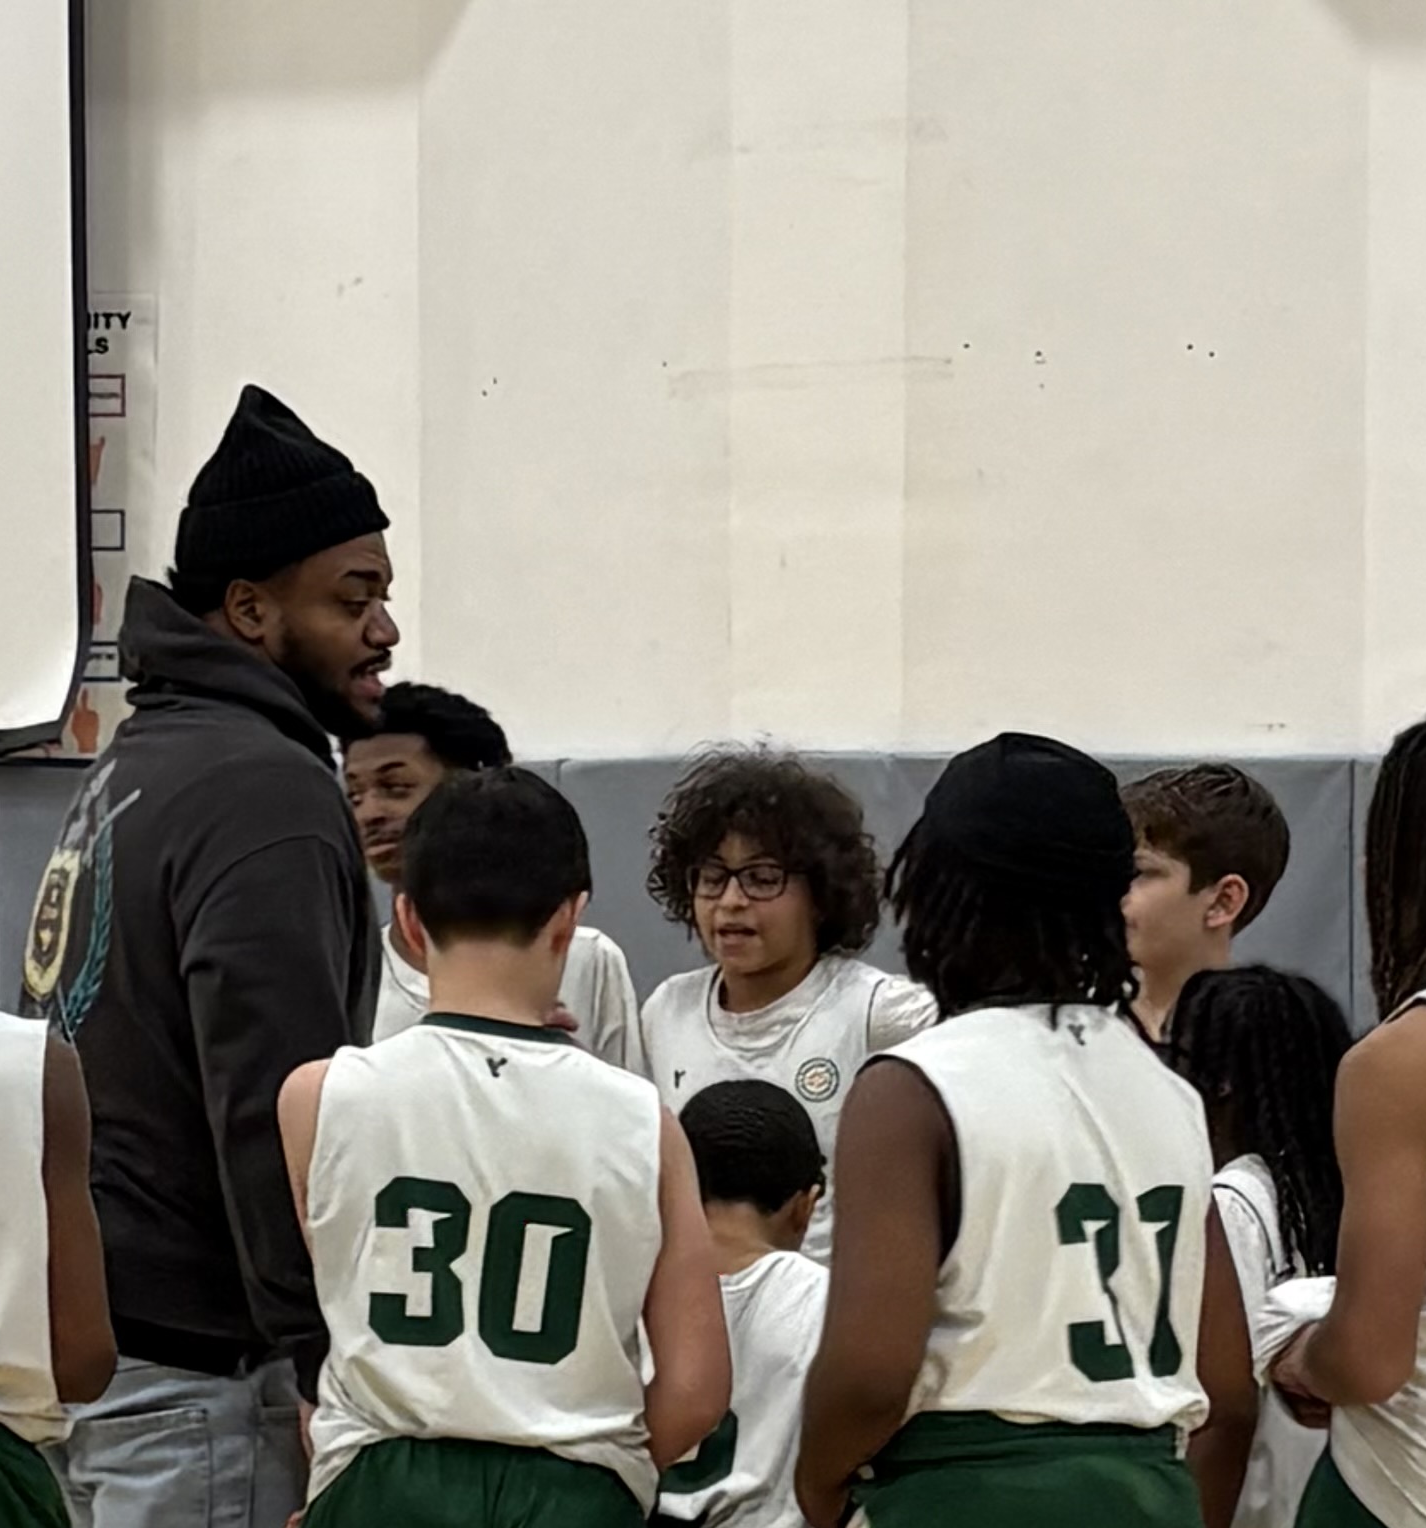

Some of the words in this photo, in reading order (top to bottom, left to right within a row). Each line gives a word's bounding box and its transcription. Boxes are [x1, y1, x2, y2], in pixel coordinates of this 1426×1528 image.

[88, 311, 131, 330] ITY
[368, 1176, 592, 1365] 30
[1055, 1182, 1185, 1383] 31
